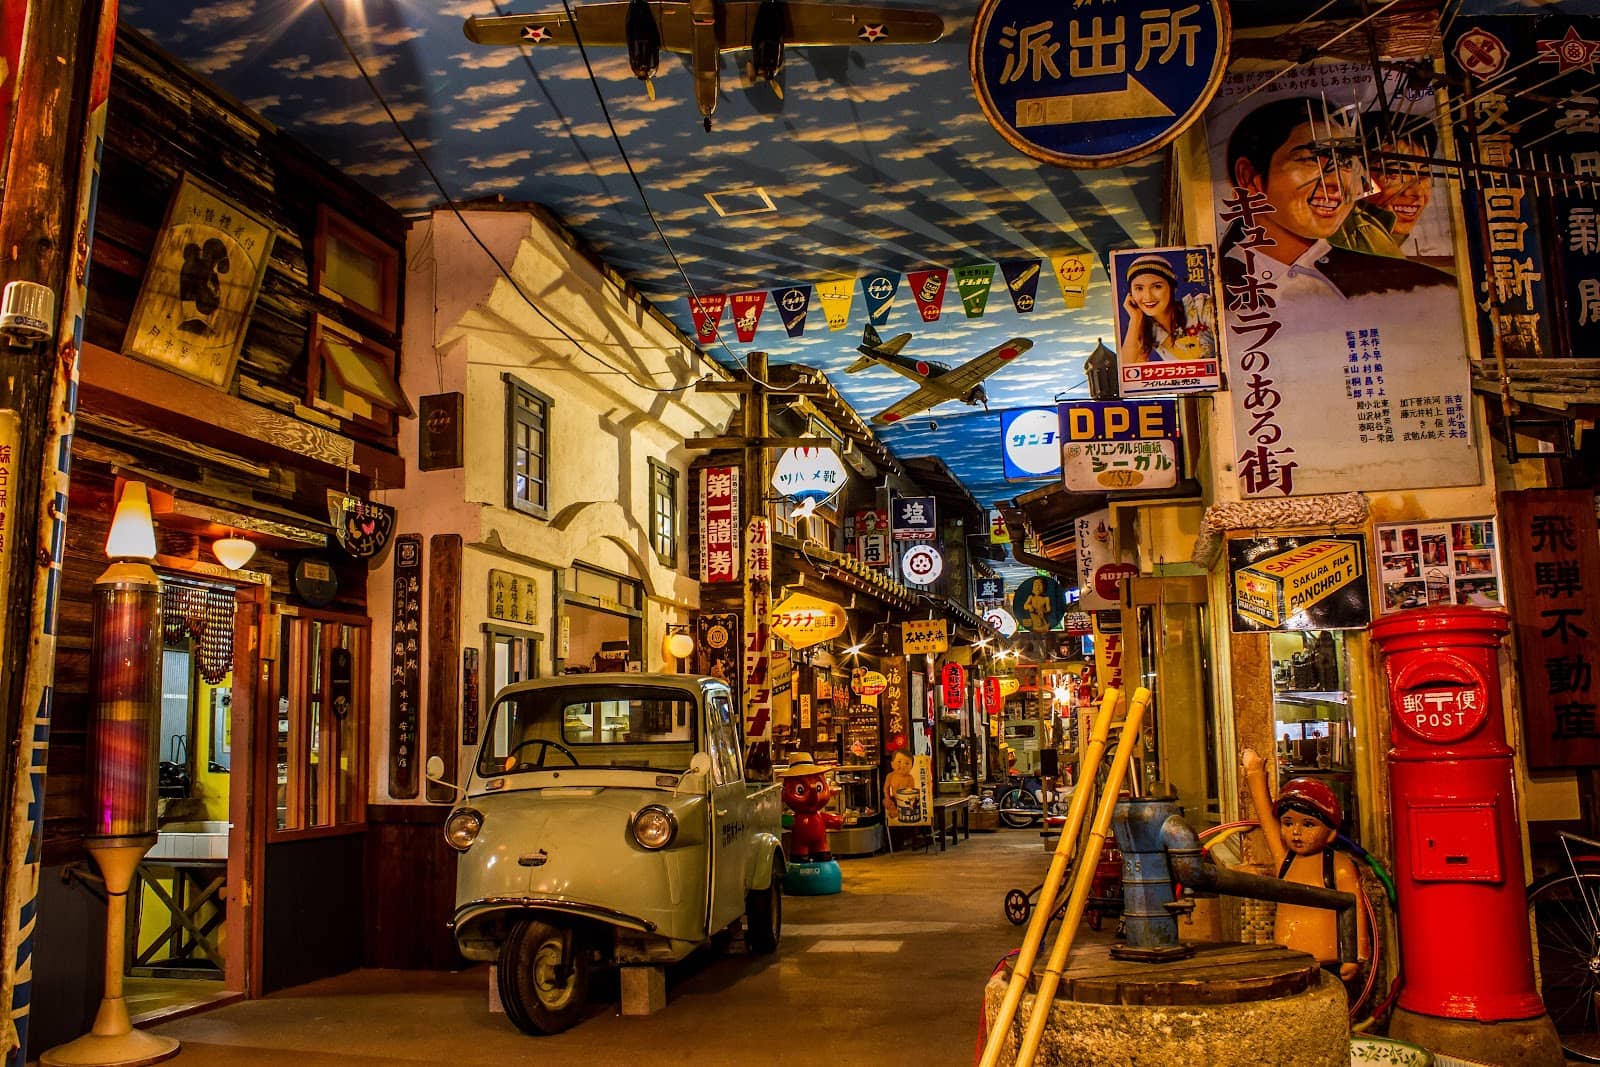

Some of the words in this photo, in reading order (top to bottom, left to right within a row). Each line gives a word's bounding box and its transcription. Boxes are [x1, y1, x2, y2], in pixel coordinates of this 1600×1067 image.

[999, 5, 1202, 84] 派出所
[959, 276, 990, 286] ナショナル
[1219, 187, 1299, 496] キューポラのある街
[1142, 365, 1205, 377] サクラカラー
[1345, 330, 1362, 399] 監督・浦山桐郎
[1359, 329, 1375, 398] 脚本・今村昌平
[1369, 328, 1385, 396] 原作・早船ちよ
[1069, 405, 1172, 440] D.P.E.
[1444, 395, 1459, 439] 浜田光夫
[1454, 394, 1468, 438] 吉永小百合
[1091, 453, 1173, 473] シーガル
[708, 473, 731, 576] 第一證券
[901, 502, 928, 525] 塩
[864, 535, 880, 562] 仁丹
[1265, 543, 1338, 573] SAKURA
[1290, 570, 1342, 612] PANCHRO
[1347, 564, 1353, 577] F
[1292, 564, 1329, 589] SAKURA
[1332, 554, 1350, 569] FILM
[771, 612, 814, 628] プラチナ
[1531, 514, 1600, 741] 飛騨不動産
[1415, 712, 1465, 728] POST
